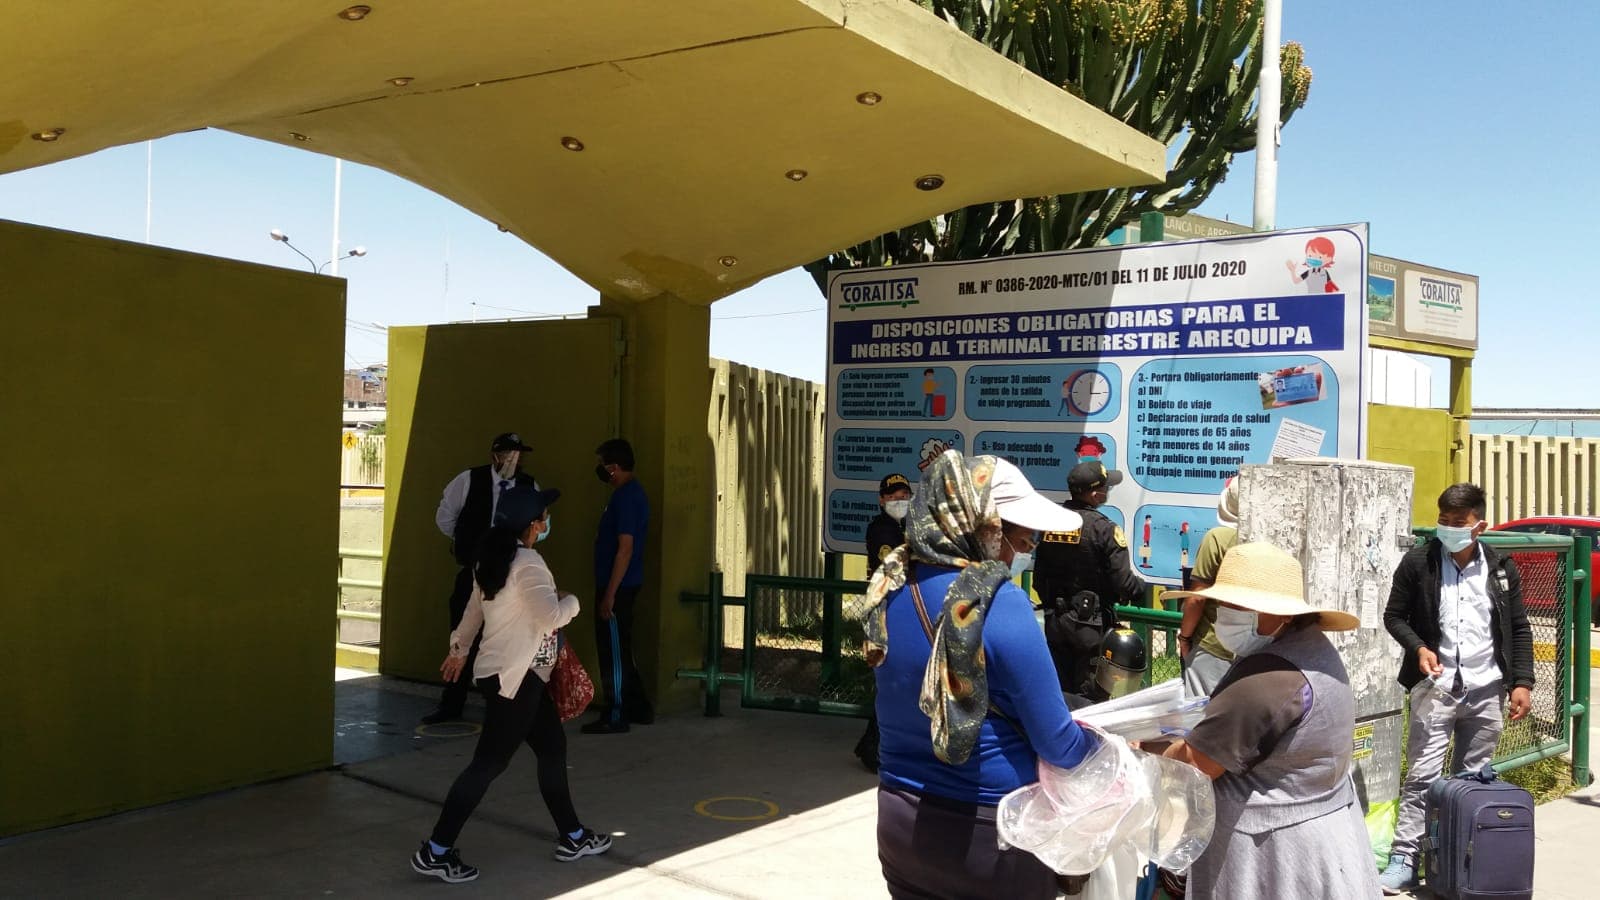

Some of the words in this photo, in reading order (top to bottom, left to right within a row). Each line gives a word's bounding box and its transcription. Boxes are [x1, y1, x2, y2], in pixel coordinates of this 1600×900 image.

[1165, 218, 1192, 233] LANCA
[1194, 223, 1206, 236] DE
[1383, 263, 1397, 274] CITY
[959, 280, 977, 295] RM.
[996, 270, 1108, 294] 0386-2020-MTC/01
[1112, 269, 1132, 284] DEL
[1137, 267, 1149, 283] 11
[1153, 266, 1169, 282] DE
[1173, 264, 1207, 281] JULIO
[1212, 260, 1247, 278] 2020
[872, 318, 1010, 339] DISPOSICIONES
[1017, 308, 1173, 333] OBLIGATORIAS
[1182, 304, 1245, 325] PARA
[1254, 302, 1280, 321] EL
[851, 341, 923, 359] INGRESO
[929, 340, 950, 356] AL
[957, 336, 1051, 357] TERMINAL
[1058, 331, 1181, 353] TERRESTRE
[1188, 326, 1312, 348] AREQUIPA
[1022, 375, 1051, 384] minutos
[1151, 372, 1182, 382] Portara
[981, 387, 999, 396] antes
[1001, 386, 1010, 396] de
[1011, 386, 1019, 396] la
[1020, 386, 1042, 396] salida
[1138, 386, 1146, 396] a)
[1149, 386, 1162, 396] DNI
[978, 398, 987, 408] de
[1138, 400, 1146, 409] b)
[1148, 400, 1175, 409] Boleto
[1177, 400, 1188, 409] de
[1191, 400, 1212, 410] viaje
[1137, 413, 1145, 423] c)
[1148, 413, 1198, 423] Declaracion
[1200, 413, 1229, 424] jurada
[1232, 413, 1243, 423] de
[1245, 413, 1271, 424] salud
[1142, 426, 1161, 436] Para
[1163, 428, 1199, 438] mayores
[1202, 427, 1213, 437] de
[1216, 427, 1227, 437] 65
[1230, 427, 1251, 437] años
[1007, 443, 1042, 453] adecuado
[1044, 443, 1054, 453] de
[1142, 440, 1161, 450] Para
[1163, 441, 1200, 450] menores
[1202, 440, 1213, 450] de
[1216, 441, 1226, 451] 14
[1228, 441, 1250, 451] años
[1026, 457, 1061, 467] protector
[1141, 453, 1160, 463] Para
[1163, 454, 1193, 465] publico
[1196, 455, 1207, 464] en
[1136, 466, 1144, 476] d)
[1147, 467, 1182, 479] Equipaje
[1184, 468, 1217, 478] minimo
